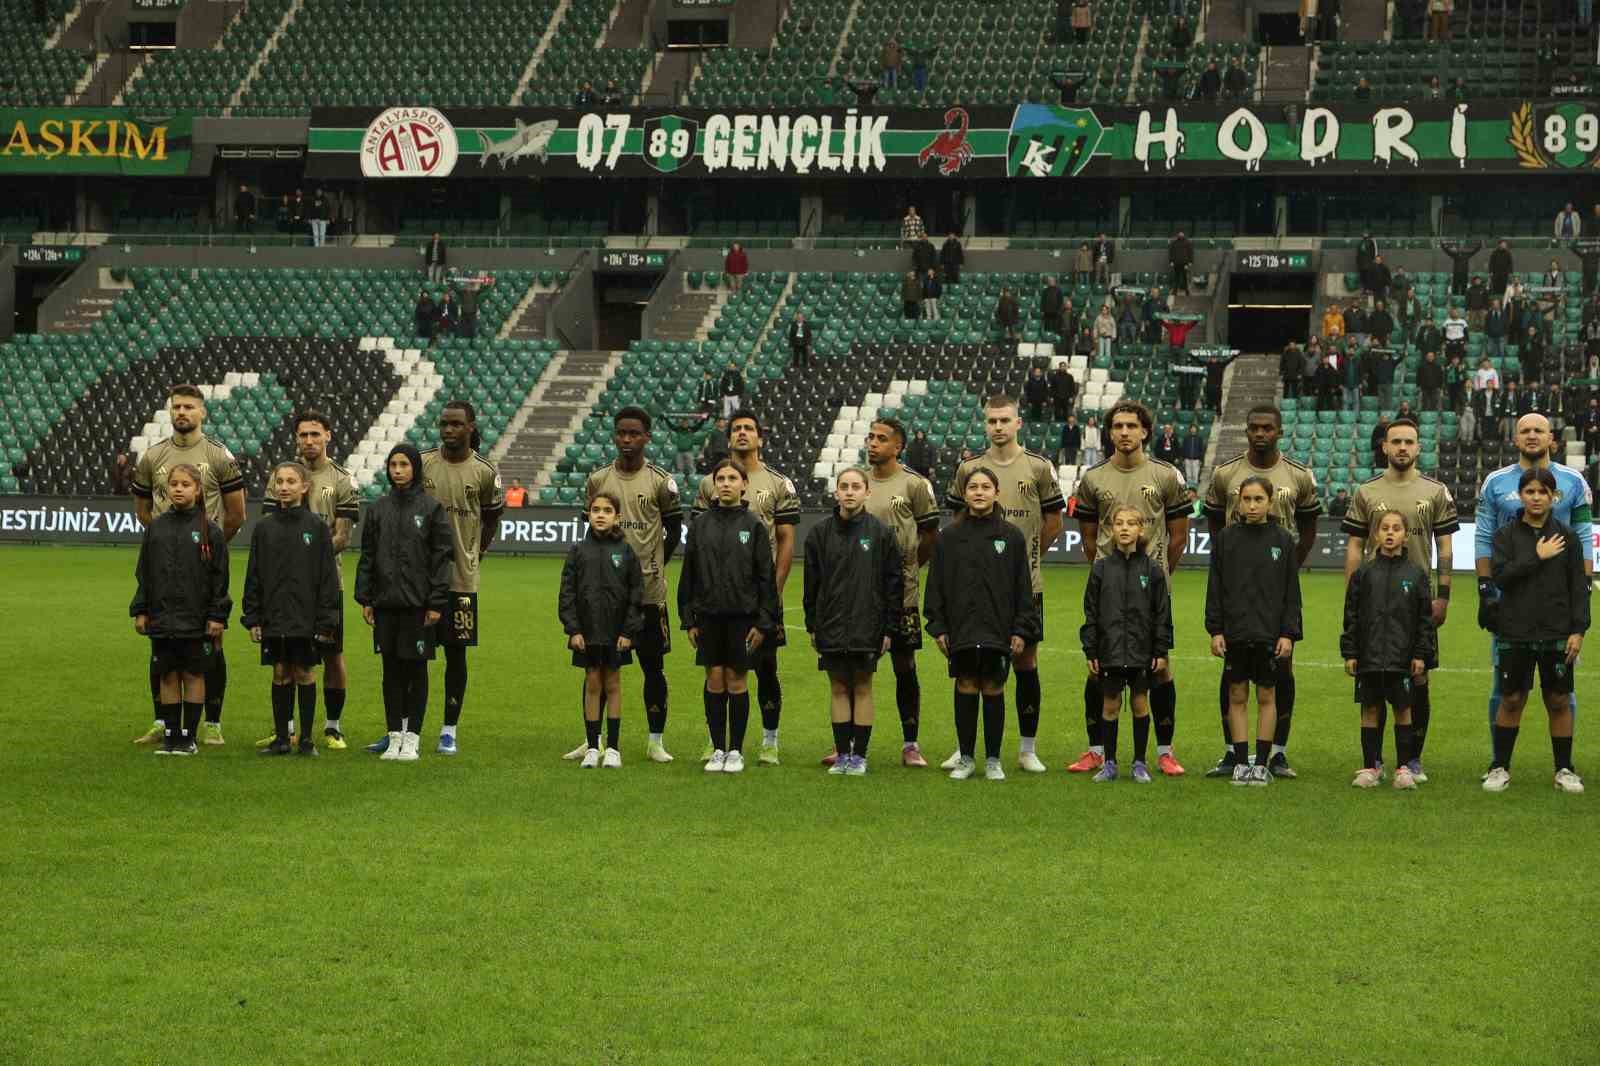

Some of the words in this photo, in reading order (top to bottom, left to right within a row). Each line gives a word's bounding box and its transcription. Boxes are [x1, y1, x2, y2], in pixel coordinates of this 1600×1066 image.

[1, 119, 169, 161] AŞKIM
[366, 109, 445, 154] ANTALYASPOR
[576, 113, 631, 172] 07
[649, 128, 690, 158] 89
[703, 108, 889, 173] GENÇLİK
[1544, 113, 1599, 153] 89
[0, 506, 101, 532] ESTİJİNİZ
[500, 517, 590, 542] PRESTİJ
[454, 610, 474, 630] 98
